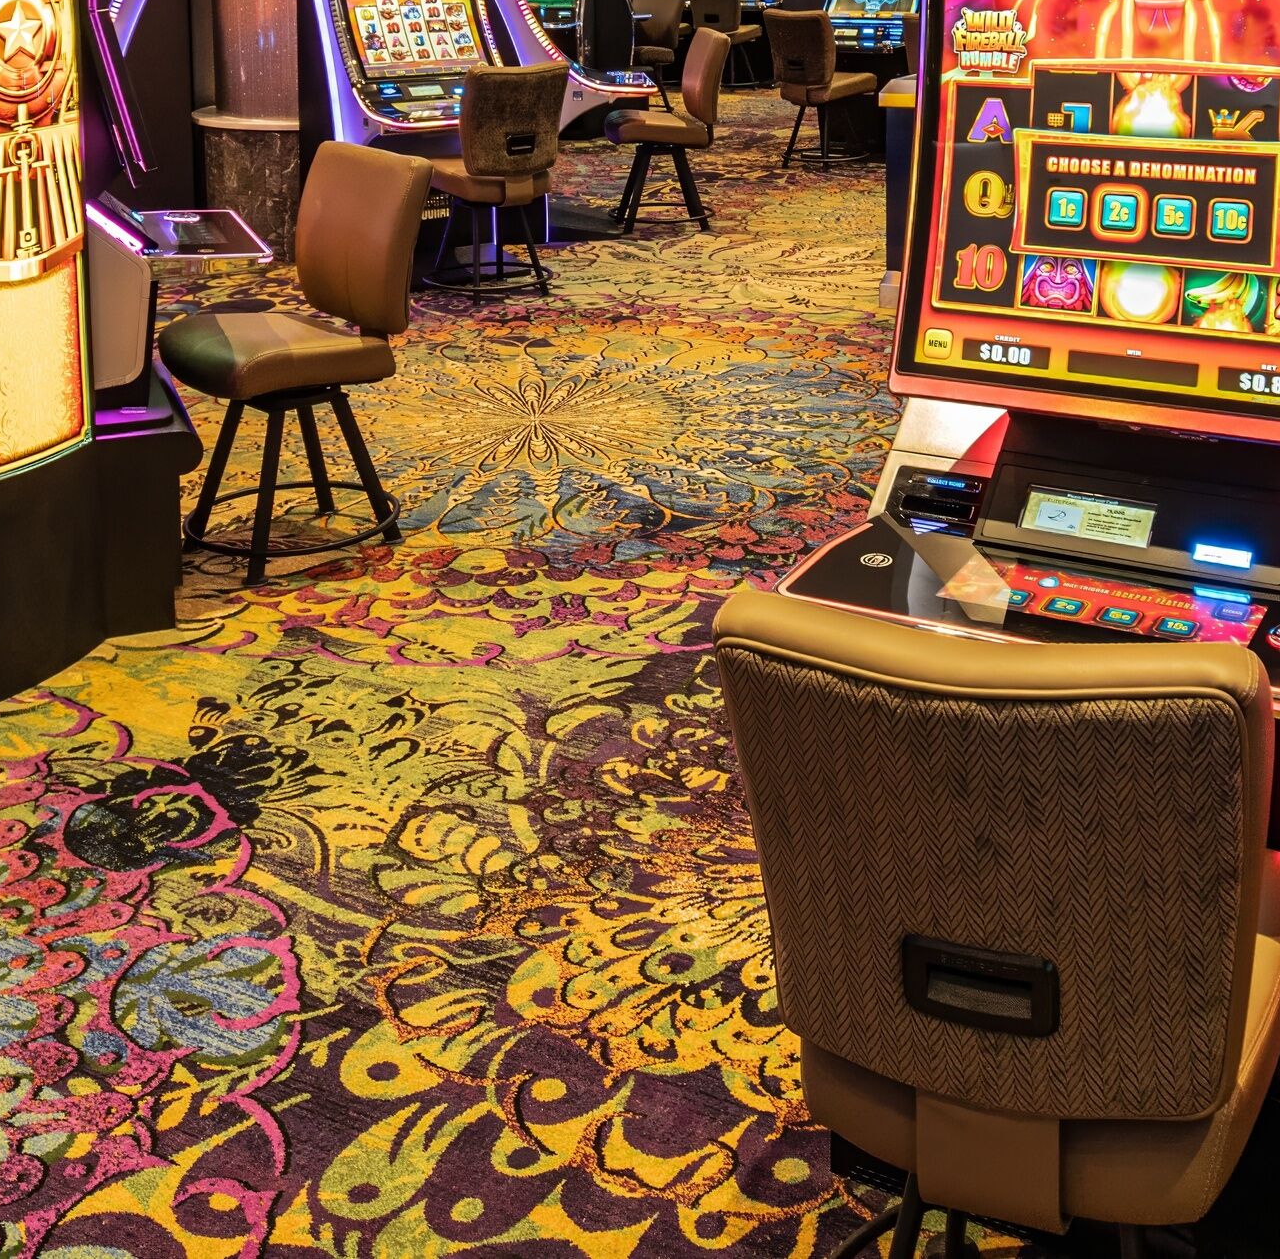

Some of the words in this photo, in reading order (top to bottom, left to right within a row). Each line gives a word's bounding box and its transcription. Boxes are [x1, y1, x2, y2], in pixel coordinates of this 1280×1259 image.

[965, 10, 1016, 33] WILD
[952, 29, 1027, 54] FIREBALL
[960, 51, 1019, 69] RUMBLE
[1046, 156, 1111, 176] CHOOSE
[1113, 159, 1126, 177] A
[1128, 160, 1257, 184] DENOMINATION
[1058, 197, 1077, 219] 1¢
[1108, 201, 1129, 223] 2¢
[1163, 205, 1185, 227] 5¢
[1215, 209, 1247, 231] 10¢
[953, 243, 1007, 292] 10
[928, 338, 949, 350] MENU
[995, 335, 1021, 343] CREDIT
[979, 343, 1031, 366] $0.00
[1110, 590, 1153, 602] JACKPOT
[1154, 597, 1197, 610] FEATURE
